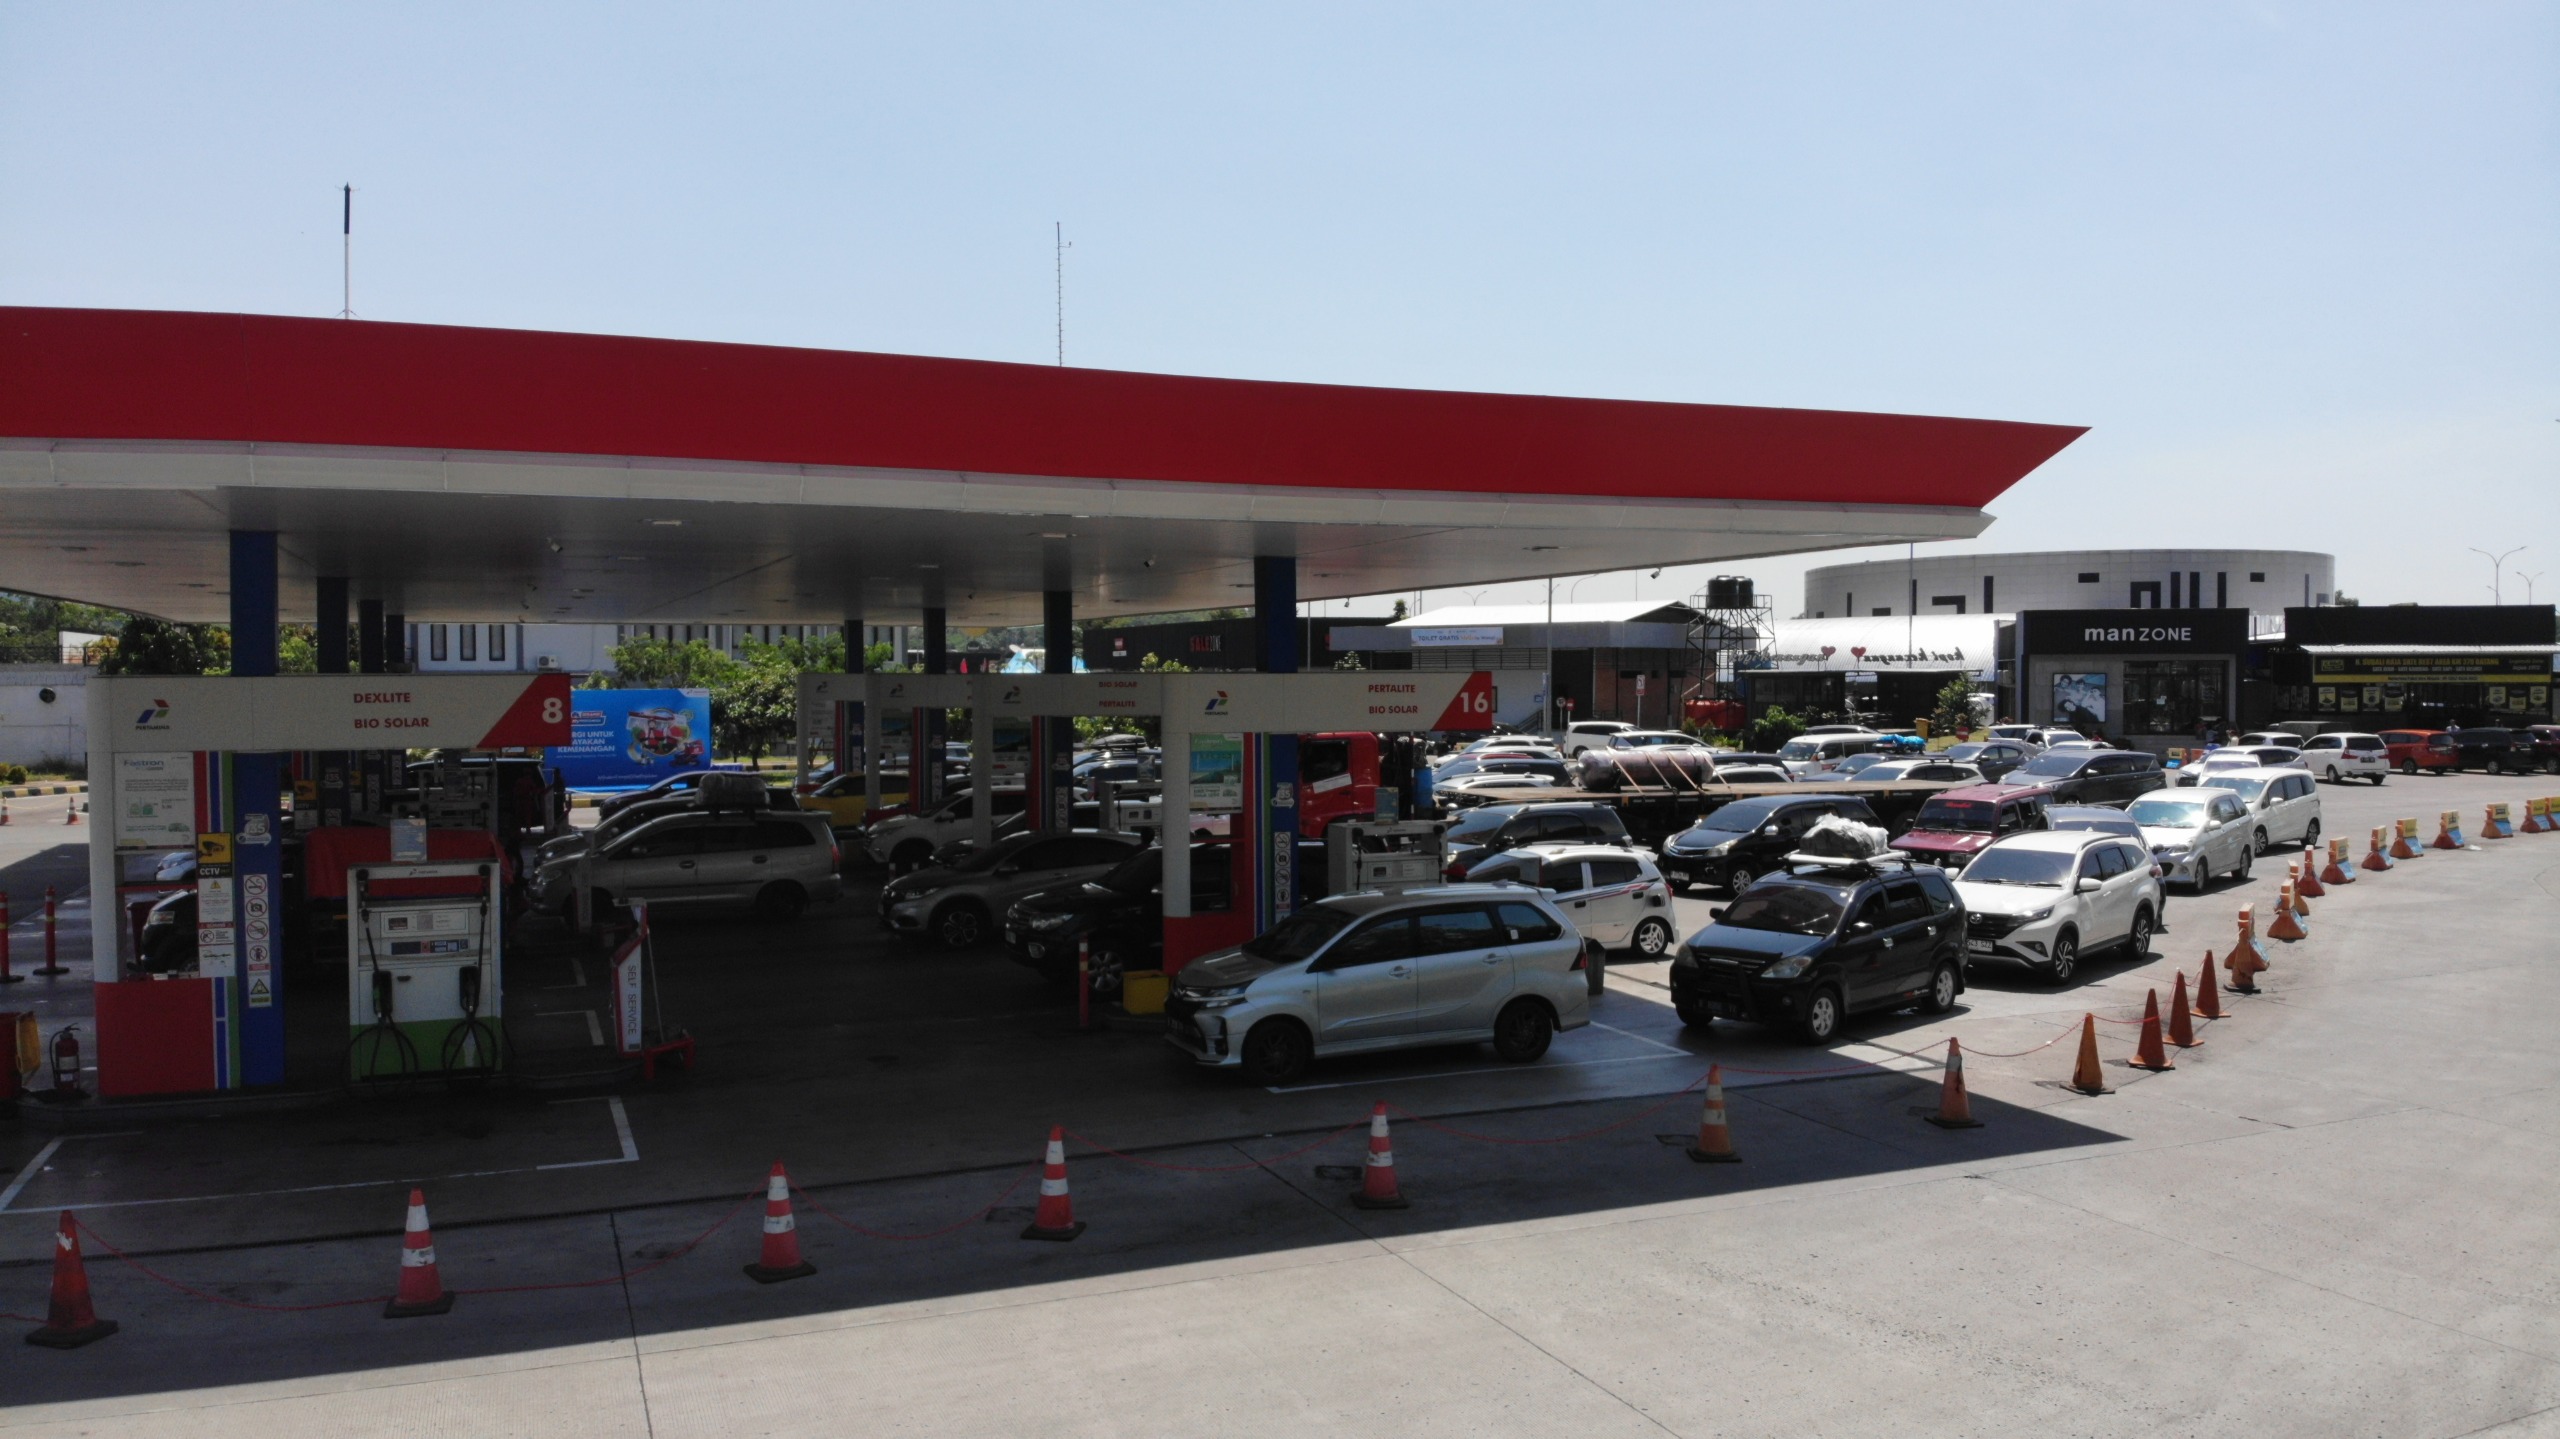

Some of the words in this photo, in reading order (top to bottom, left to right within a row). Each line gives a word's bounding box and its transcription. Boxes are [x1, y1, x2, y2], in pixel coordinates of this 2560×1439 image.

[1368, 684, 1416, 693] PERTALITE
[353, 692, 411, 704] DEXLITE
[1098, 700, 1136, 708] PERTALITE
[1459, 692, 1489, 714] 16
[541, 698, 564, 725] 8
[1369, 706, 1386, 714] BIO
[1389, 705, 1418, 714] SOLAR
[354, 718, 380, 730] BIO
[384, 717, 430, 729] SOLAR
[587, 730, 615, 738] UNTUK
[557, 745, 616, 753] KEMENANGAN
[124, 759, 165, 767] Fastron
[199, 867, 221, 876] CCTV
[627, 965, 637, 988] SELF
[627, 994, 637, 1035] SERVICE
